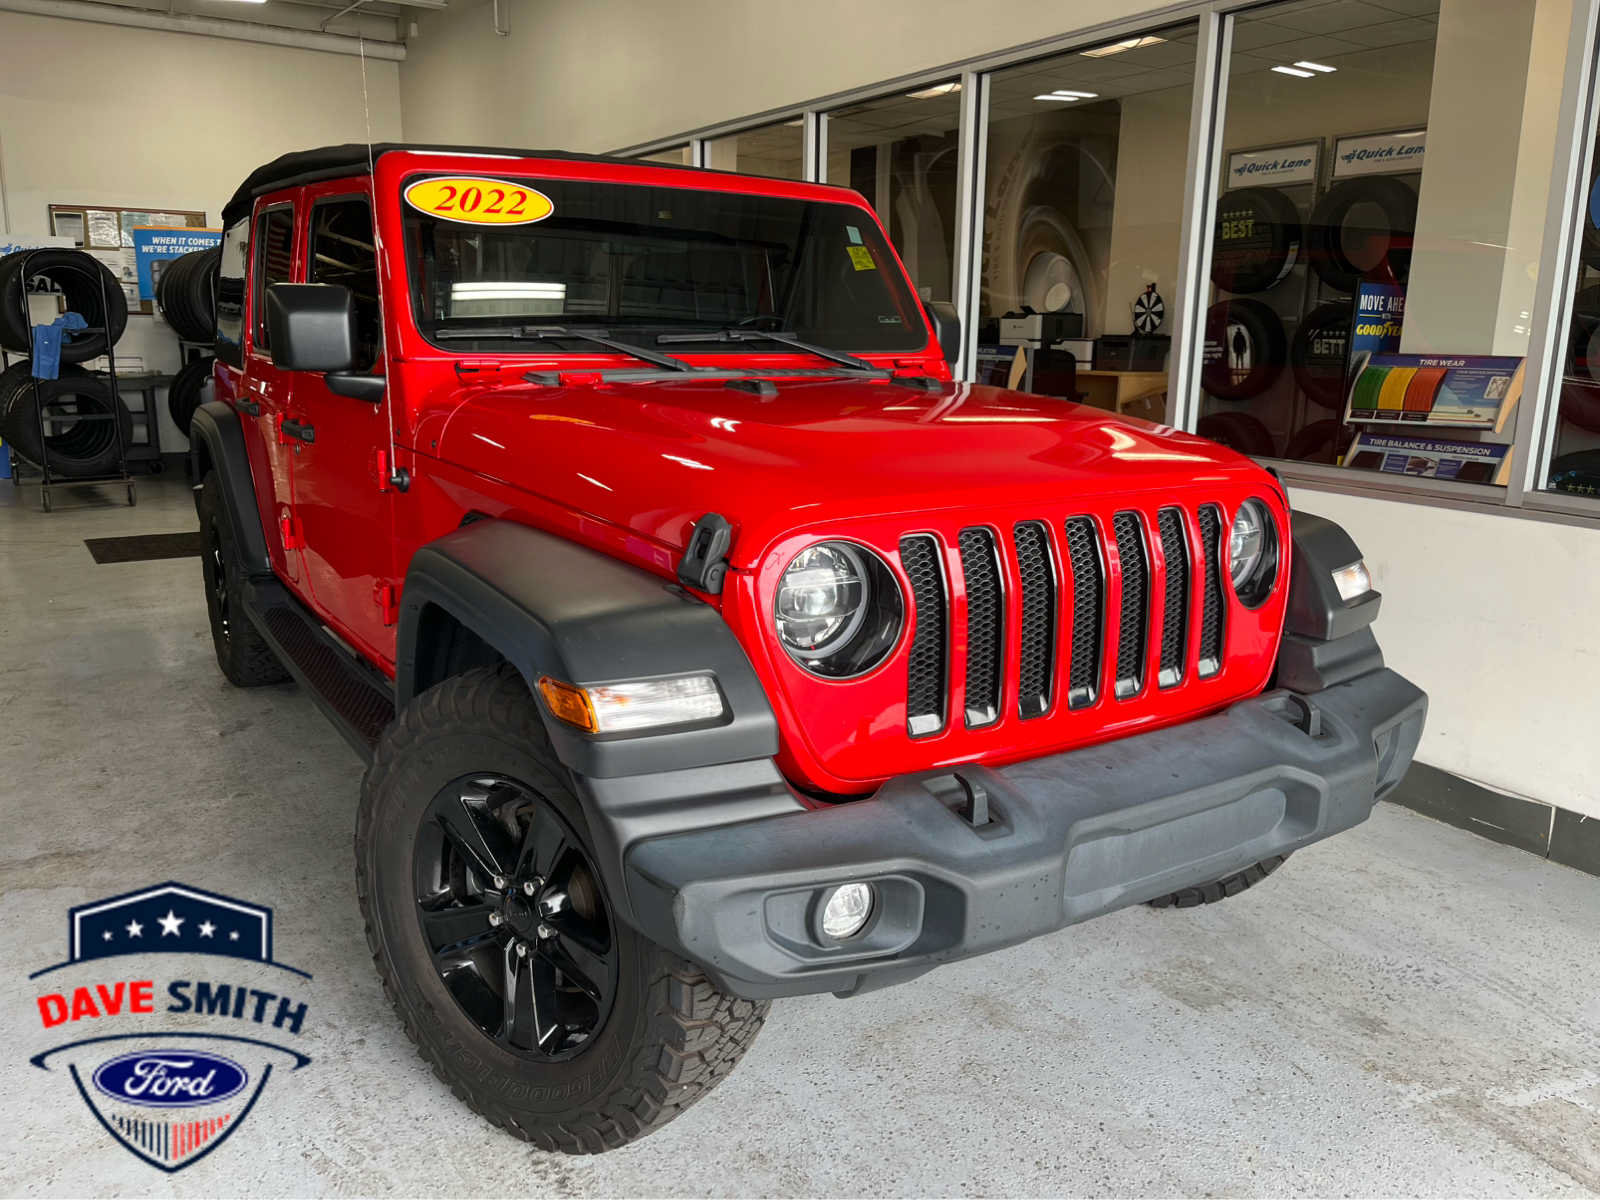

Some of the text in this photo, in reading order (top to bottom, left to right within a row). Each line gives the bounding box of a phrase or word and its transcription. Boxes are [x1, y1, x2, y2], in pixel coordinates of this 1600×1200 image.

[1357, 146, 1393, 161] Quick
[1247, 161, 1280, 174] Quick
[1280, 158, 1312, 169] Lane
[434, 186, 528, 215] 2022
[1222, 219, 1255, 240] BEST
[141, 245, 168, 254] WE'RE
[152, 236, 177, 245] WHEN
[178, 237, 187, 245] IT
[188, 238, 214, 247] COMES
[1359, 294, 1385, 311] MOVE
[1419, 359, 1439, 367] TIRE
[1369, 438, 1492, 456] TIRE BALANCE & SUSPENSION
